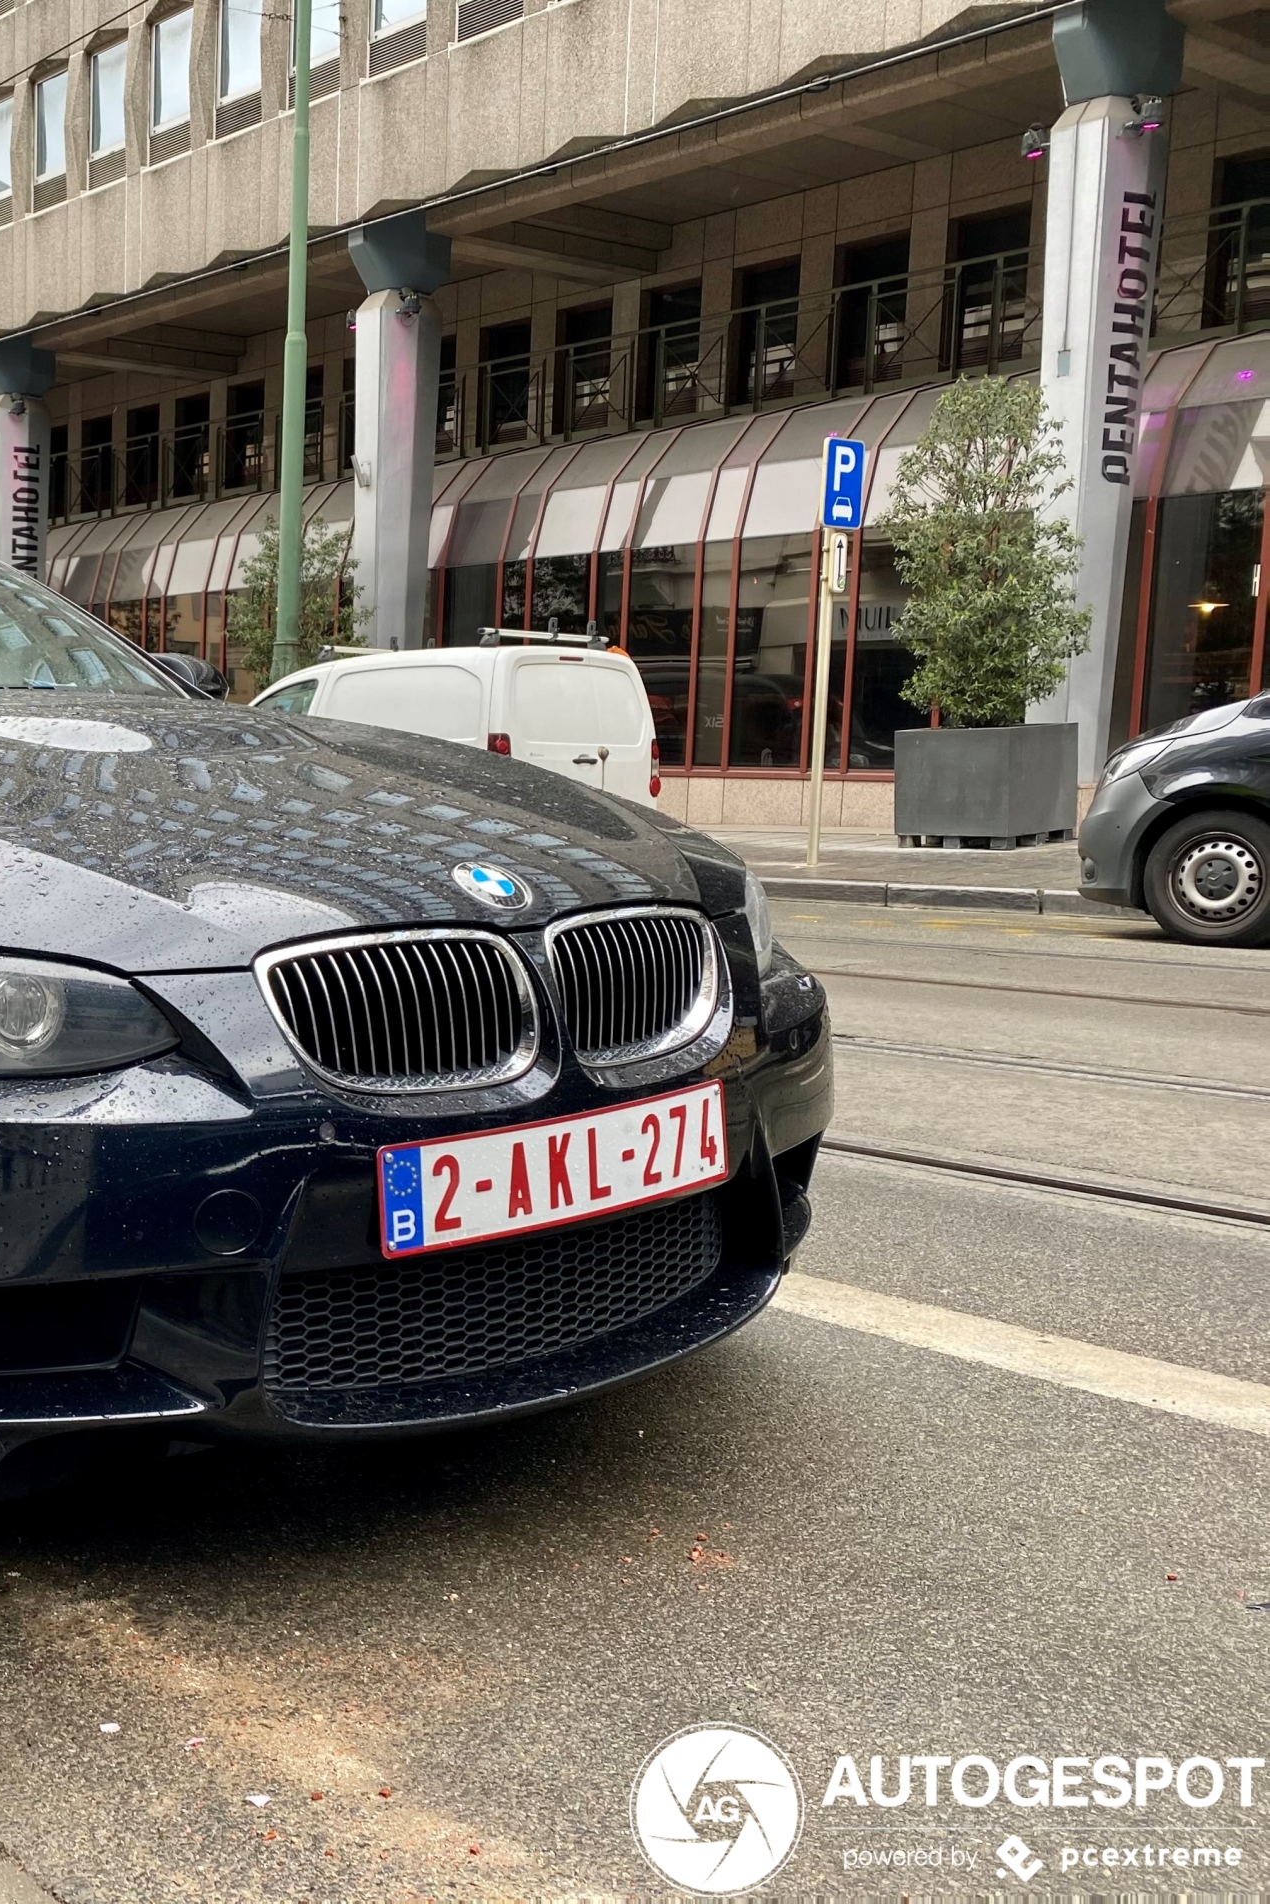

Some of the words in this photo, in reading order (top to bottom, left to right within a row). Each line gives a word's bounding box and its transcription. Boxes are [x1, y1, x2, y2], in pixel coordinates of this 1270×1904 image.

[1102, 191, 1157, 485] PENTAHOTEL
[833, 445, 856, 491] P
[392, 1209, 417, 1242] B
[432, 1098, 718, 1232] 2-AKL-274
